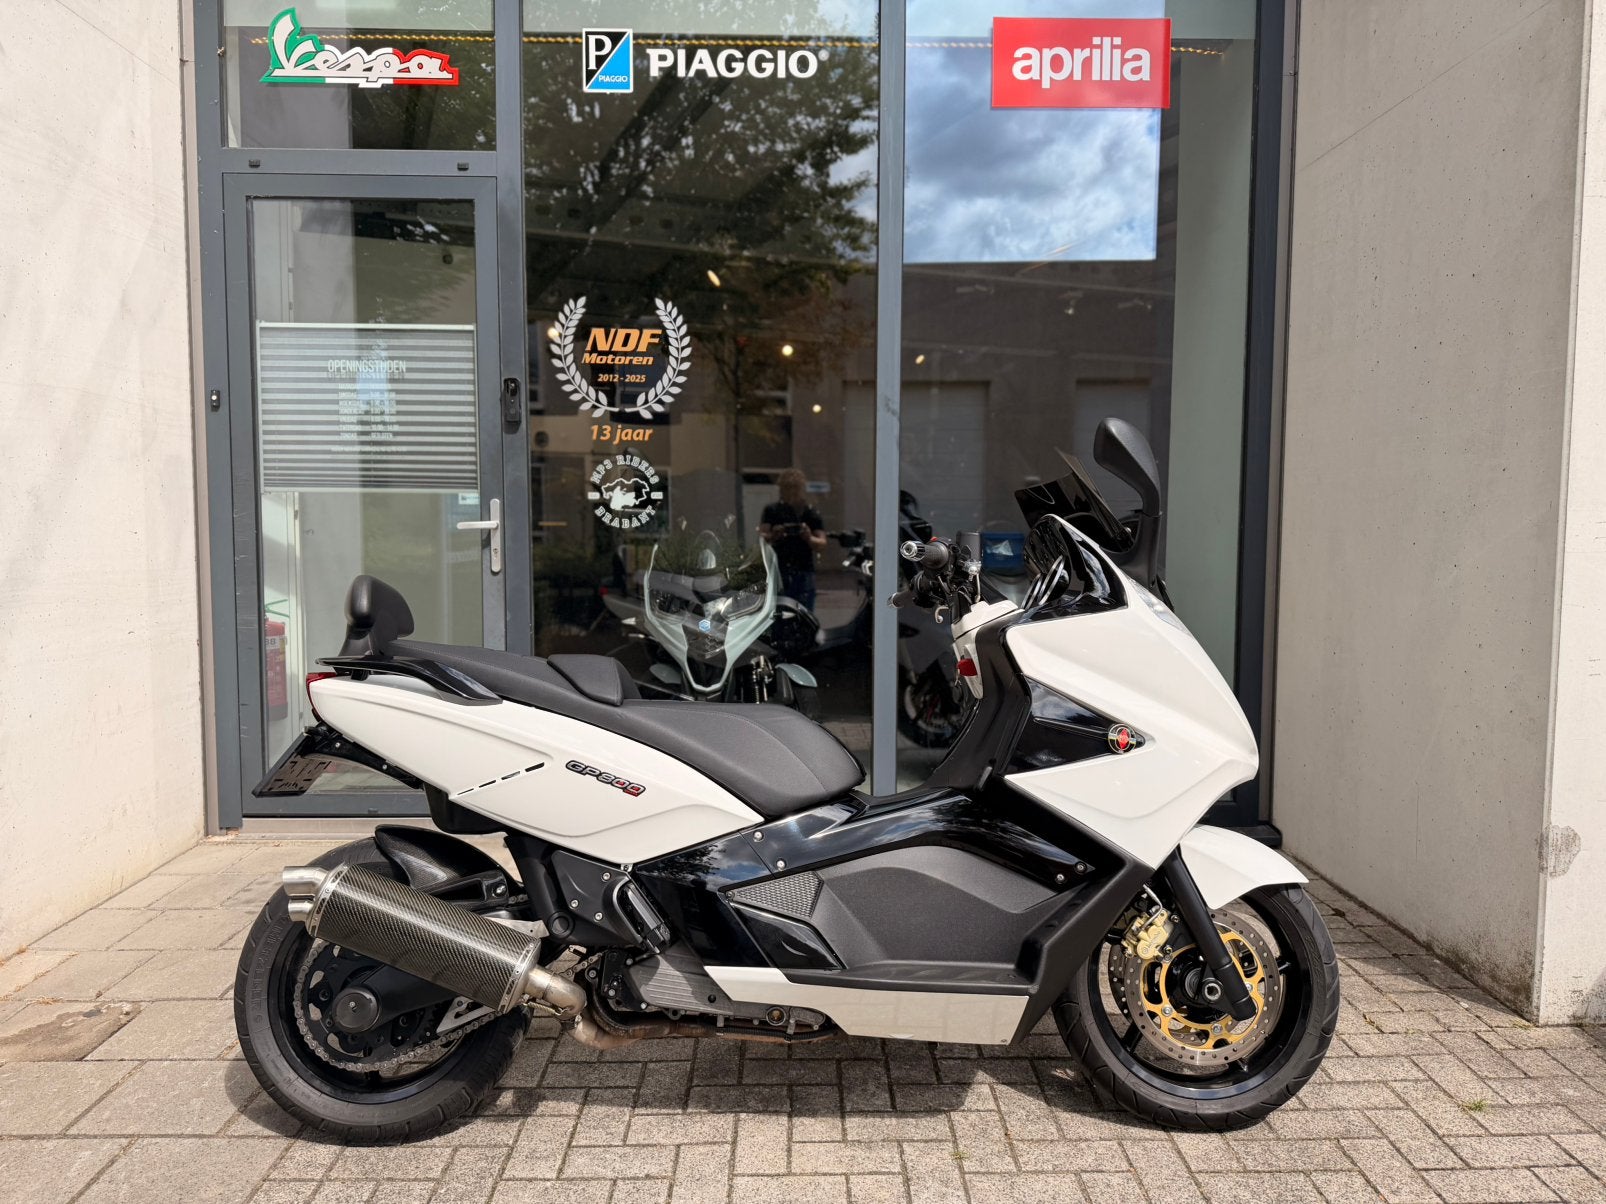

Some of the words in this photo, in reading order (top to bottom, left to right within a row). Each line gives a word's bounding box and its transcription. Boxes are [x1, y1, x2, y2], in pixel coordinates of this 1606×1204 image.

[267, 11, 456, 85] Vespa
[1011, 36, 1151, 89] aprilia
[598, 74, 628, 83] PIAGGIO
[584, 327, 663, 352] NDF
[581, 352, 654, 366] Motoren
[597, 373, 620, 383] 2012
[625, 374, 647, 383] 2025
[590, 424, 612, 441] 13
[612, 423, 654, 445] jaar
[615, 454, 660, 485] RIDERS
[594, 504, 657, 529] BRABANT
[565, 759, 647, 797] GP800
